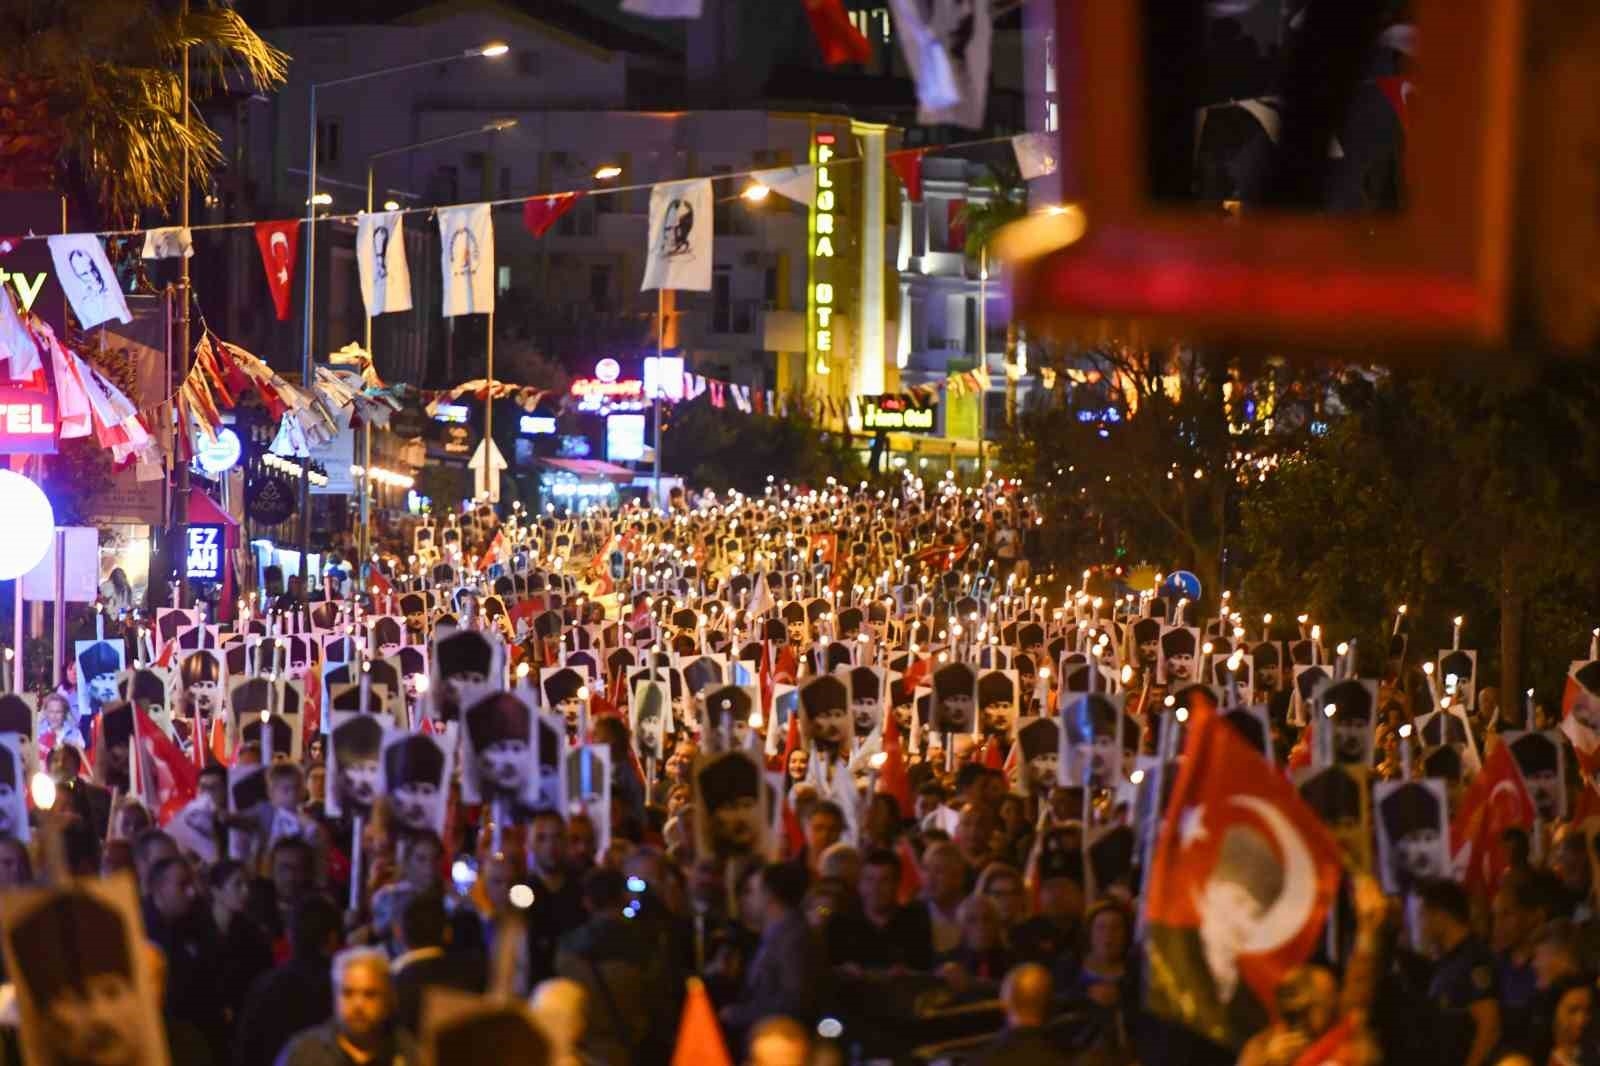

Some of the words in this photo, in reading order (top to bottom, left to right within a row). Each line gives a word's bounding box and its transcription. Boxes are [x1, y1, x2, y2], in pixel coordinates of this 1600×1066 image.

[816, 145, 834, 257] FLORA
[816, 283, 833, 375] OTEL
[187, 548, 218, 570] AH
